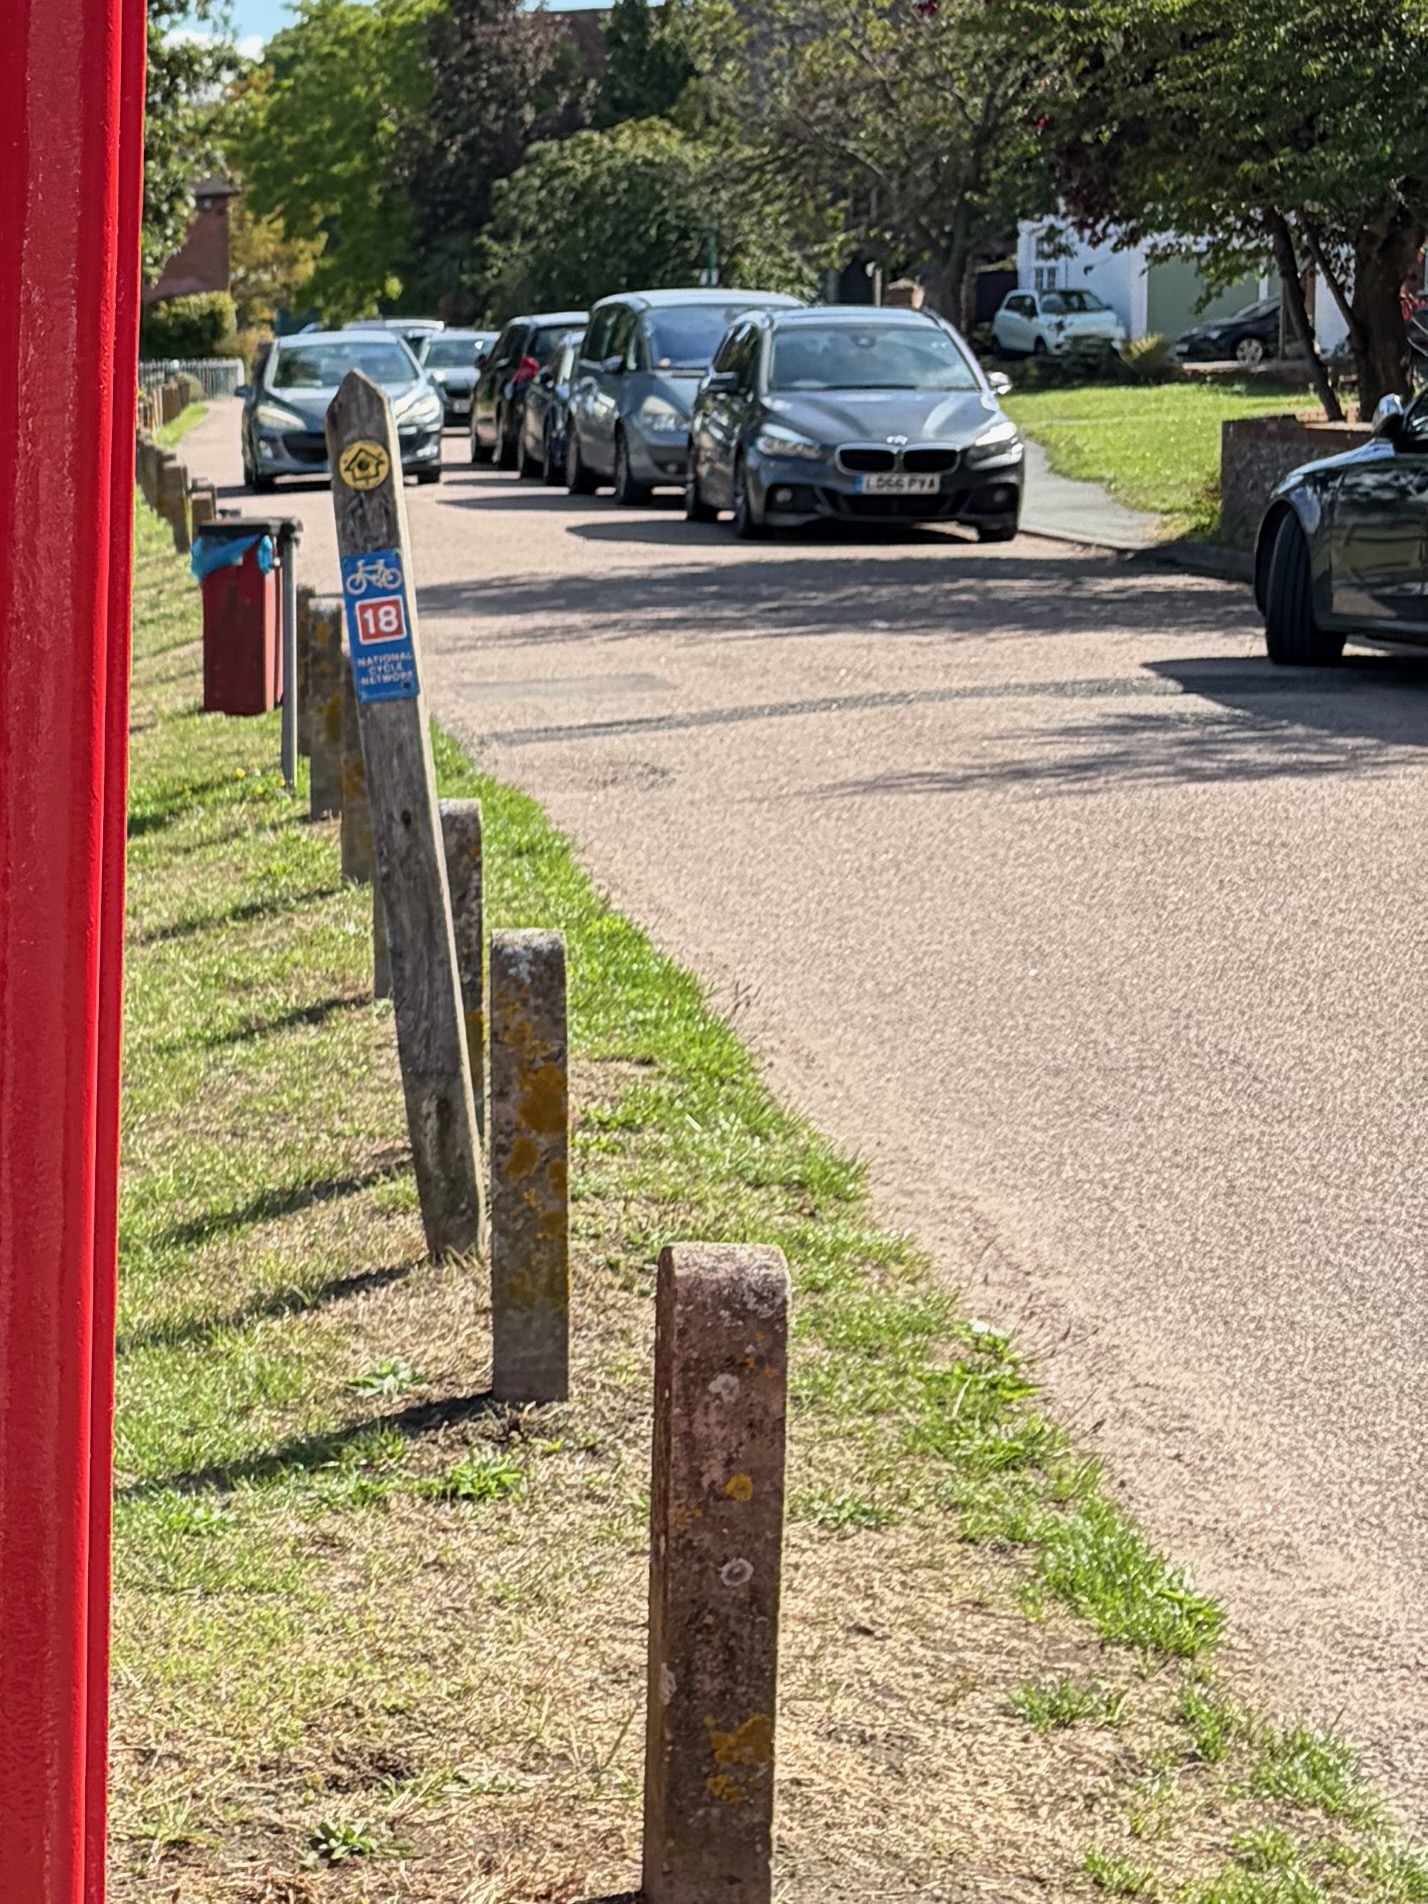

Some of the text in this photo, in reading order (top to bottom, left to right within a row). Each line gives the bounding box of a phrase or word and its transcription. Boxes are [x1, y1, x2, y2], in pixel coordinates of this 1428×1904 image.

[363, 605, 399, 635] 18
[357, 651, 413, 667] NATIONAL
[368, 661, 403, 675] CYCLE
[360, 671, 413, 686] NETWORK
